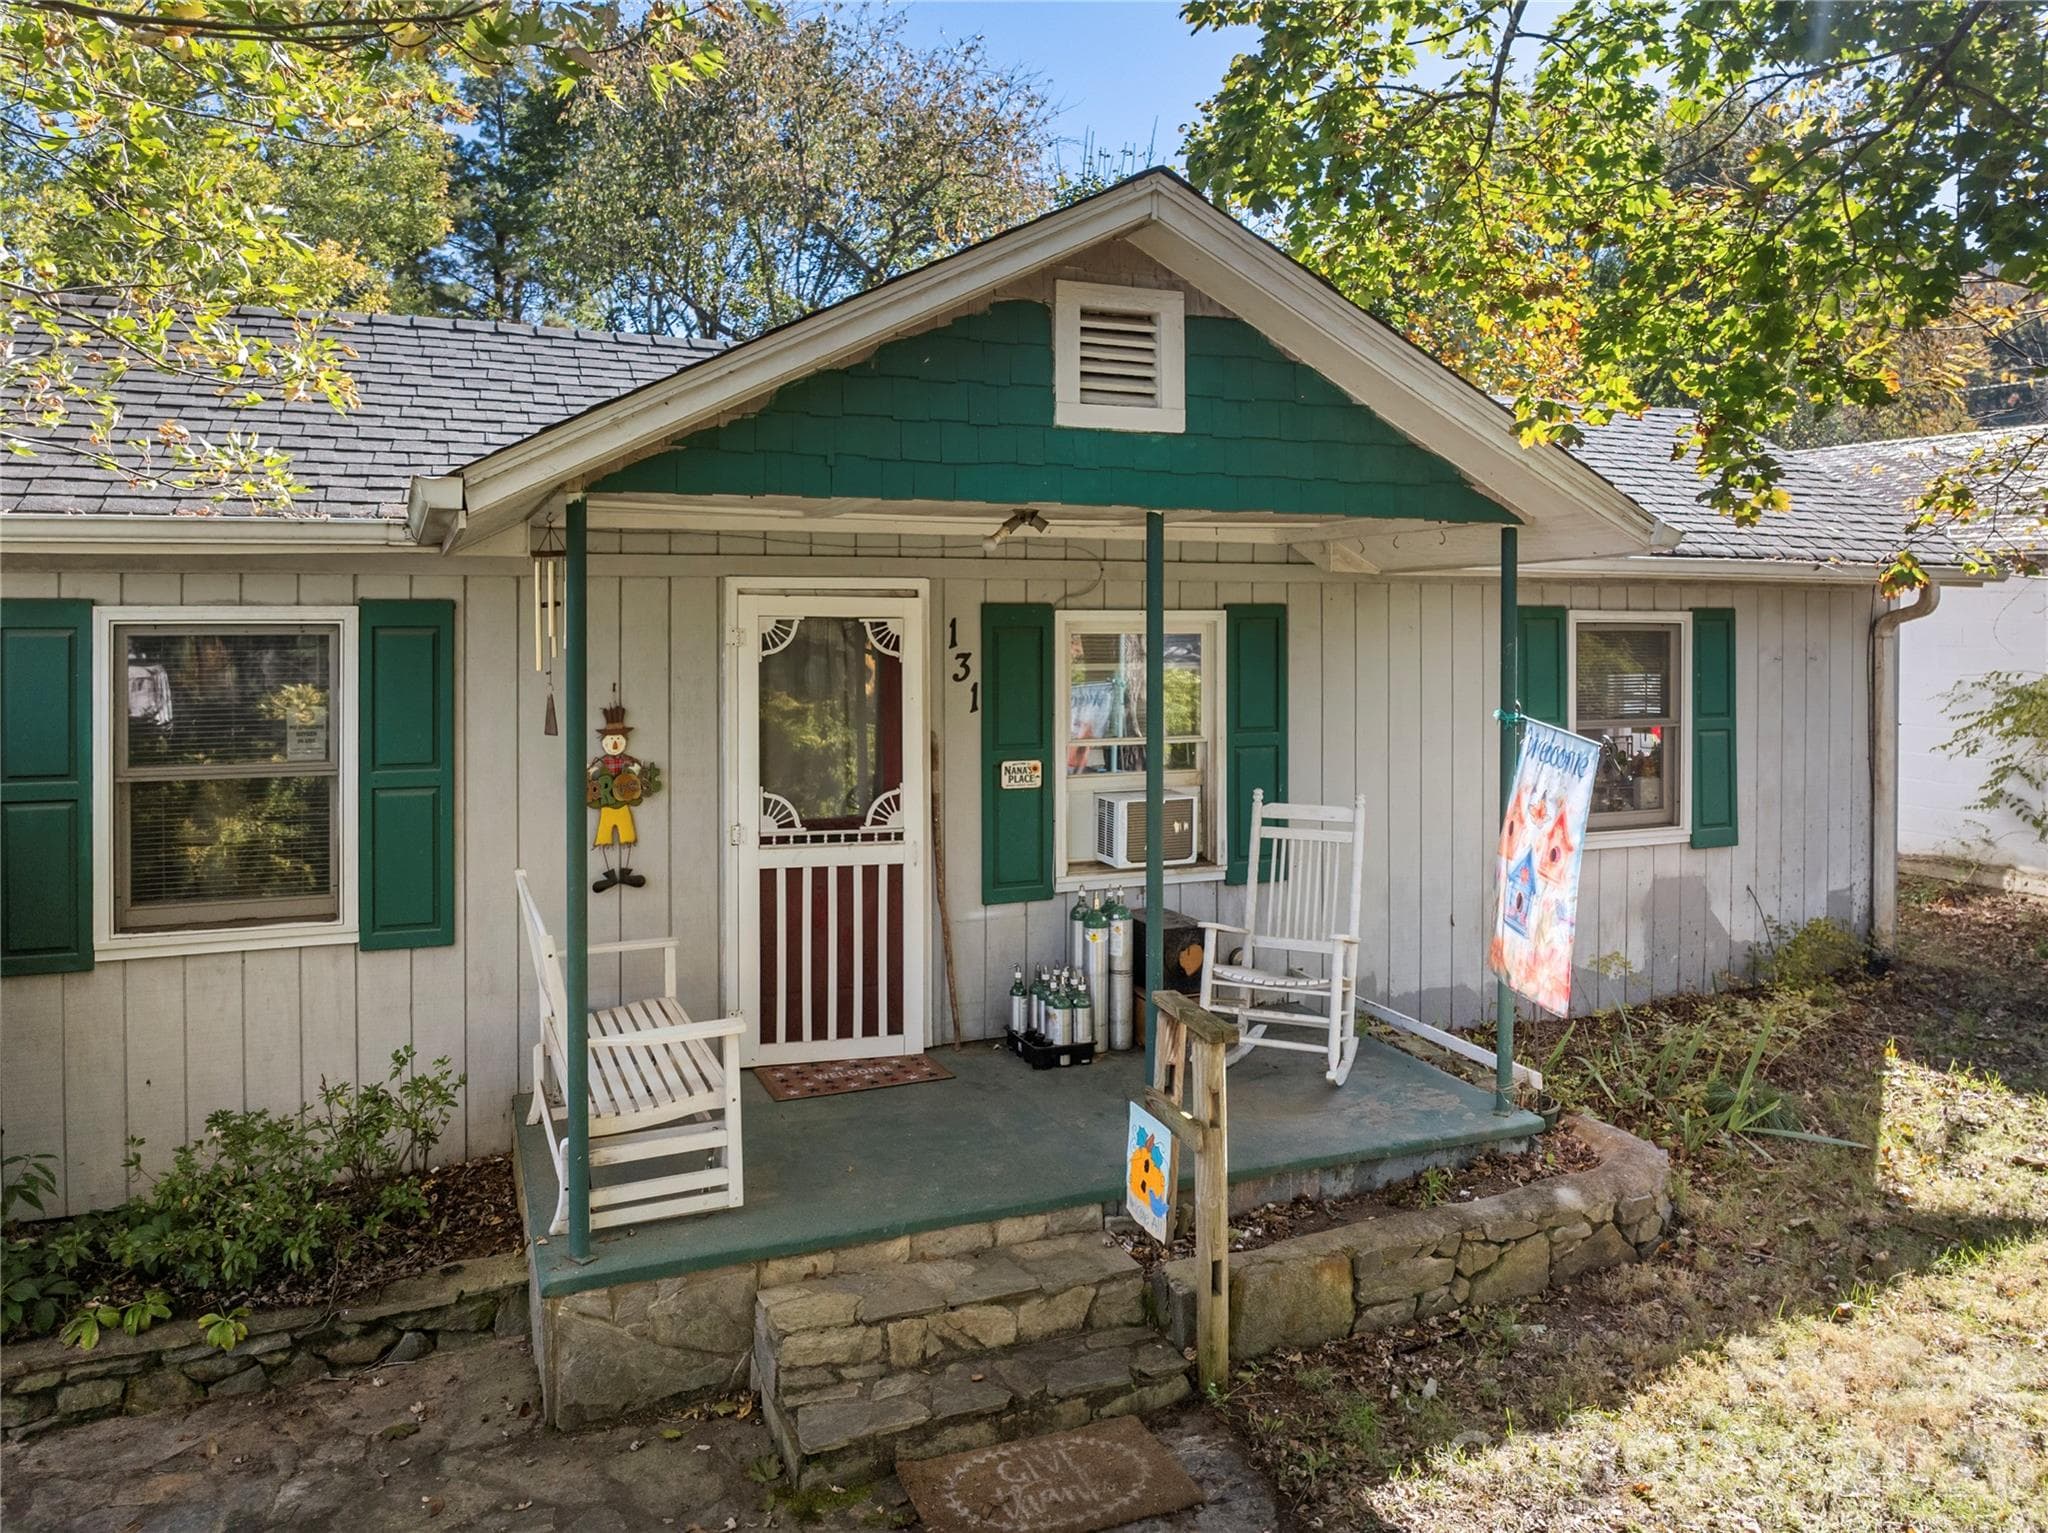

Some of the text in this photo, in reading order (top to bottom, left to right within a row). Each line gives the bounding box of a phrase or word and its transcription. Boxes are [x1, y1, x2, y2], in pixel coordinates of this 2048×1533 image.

[949, 617, 978, 713] 131
[1004, 765, 1032, 776] NANA'S
[1008, 774, 1035, 784] PLACE
[814, 1066, 893, 1080] WELCOME
